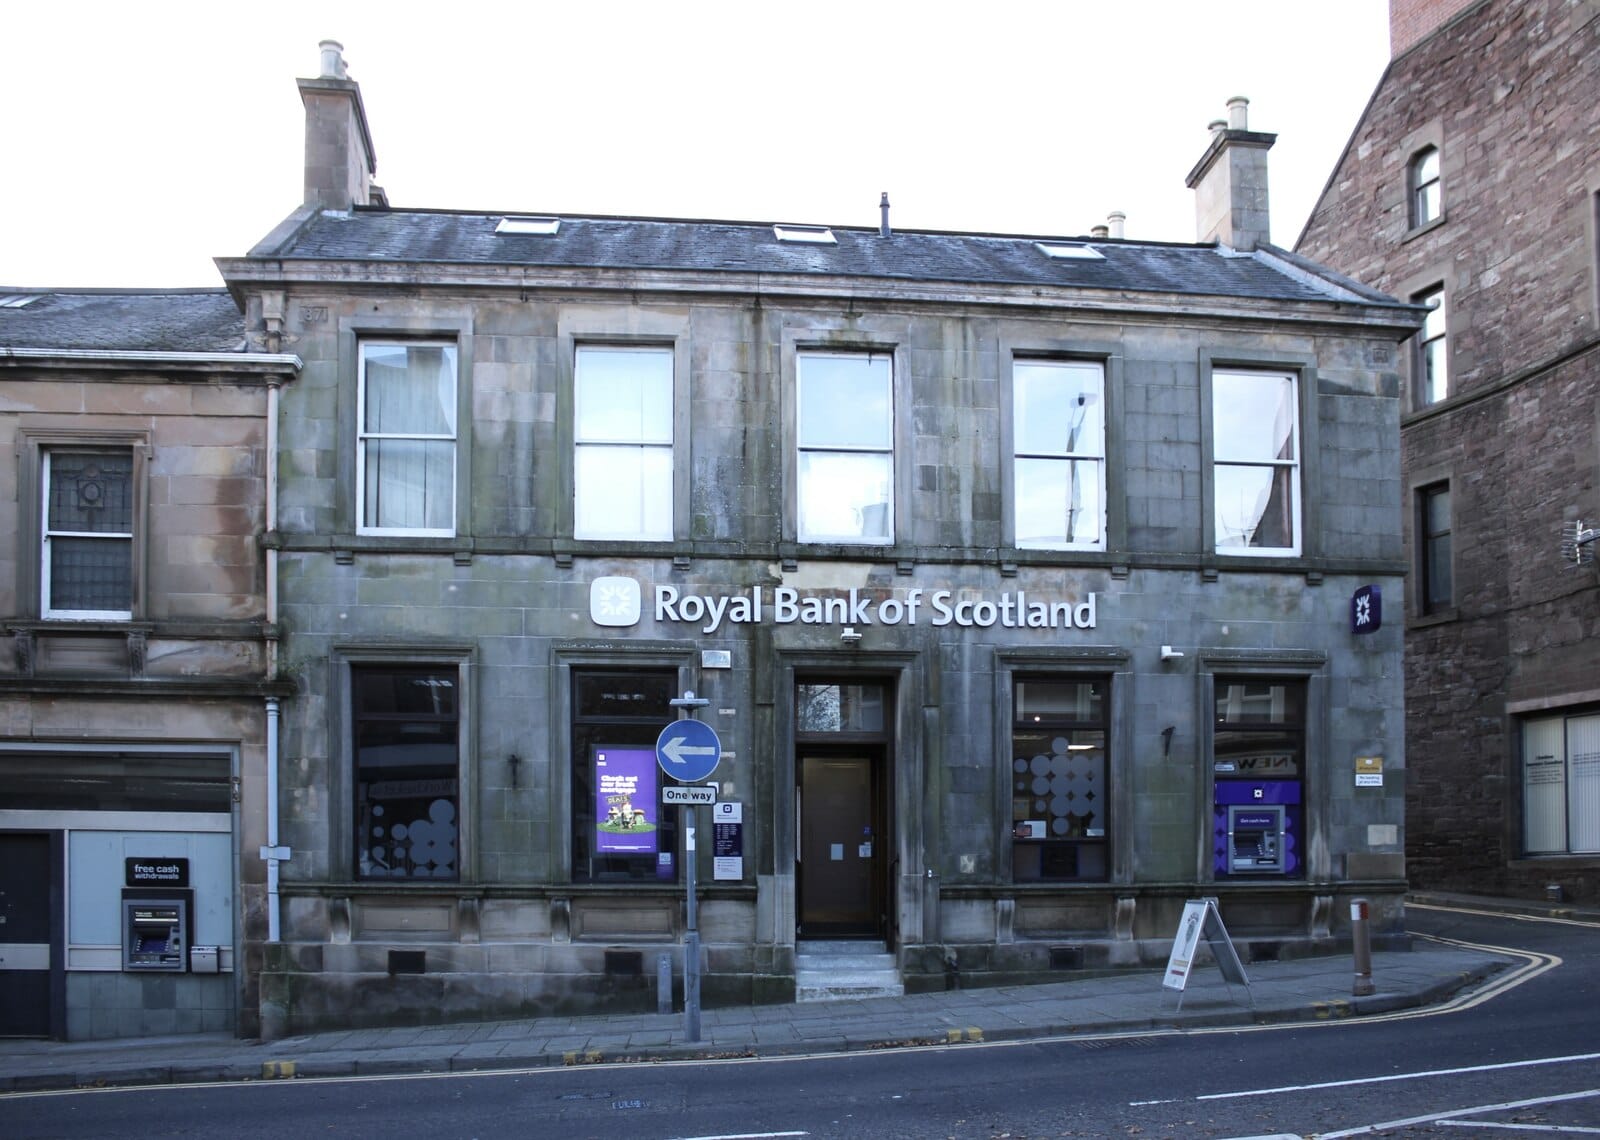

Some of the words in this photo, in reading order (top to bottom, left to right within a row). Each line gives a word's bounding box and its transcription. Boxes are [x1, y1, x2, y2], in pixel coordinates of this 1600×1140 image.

[655, 585, 762, 634] Royal
[775, 587, 872, 624] Bank
[878, 588, 922, 625] of
[932, 590, 1097, 628] Scotland
[666, 790, 688, 799] One
[691, 792, 712, 801] way
[134, 864, 154, 873] free
[156, 864, 179, 873] cash
